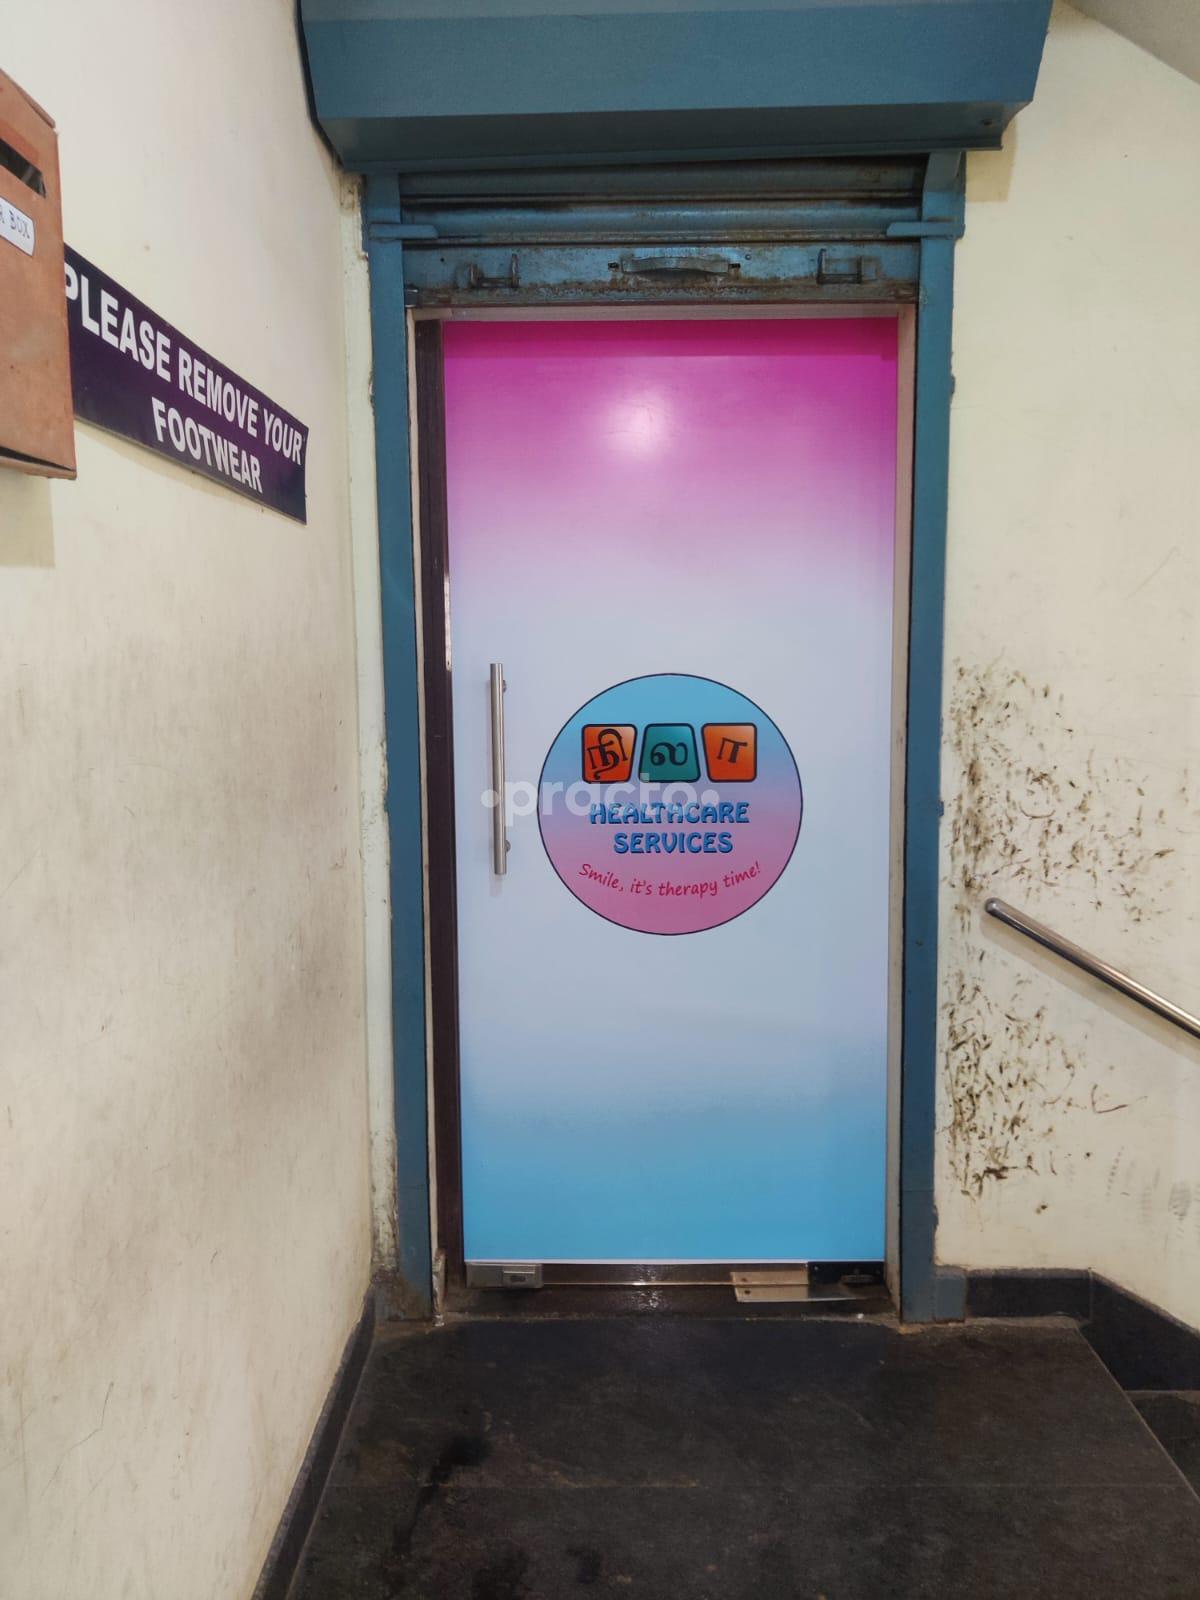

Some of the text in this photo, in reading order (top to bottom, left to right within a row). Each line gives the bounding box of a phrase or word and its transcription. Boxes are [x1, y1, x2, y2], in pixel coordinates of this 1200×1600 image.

[9, 209, 30, 239] BOX
[64, 262, 302, 465] PLEASE REMOVE YOUR
[152, 396, 263, 493] FOOTWEAR
[590, 801, 750, 825] HEALTHCARE
[613, 832, 734, 854] SERVICES
[578, 860, 761, 898] Smile, it's therapy time!
